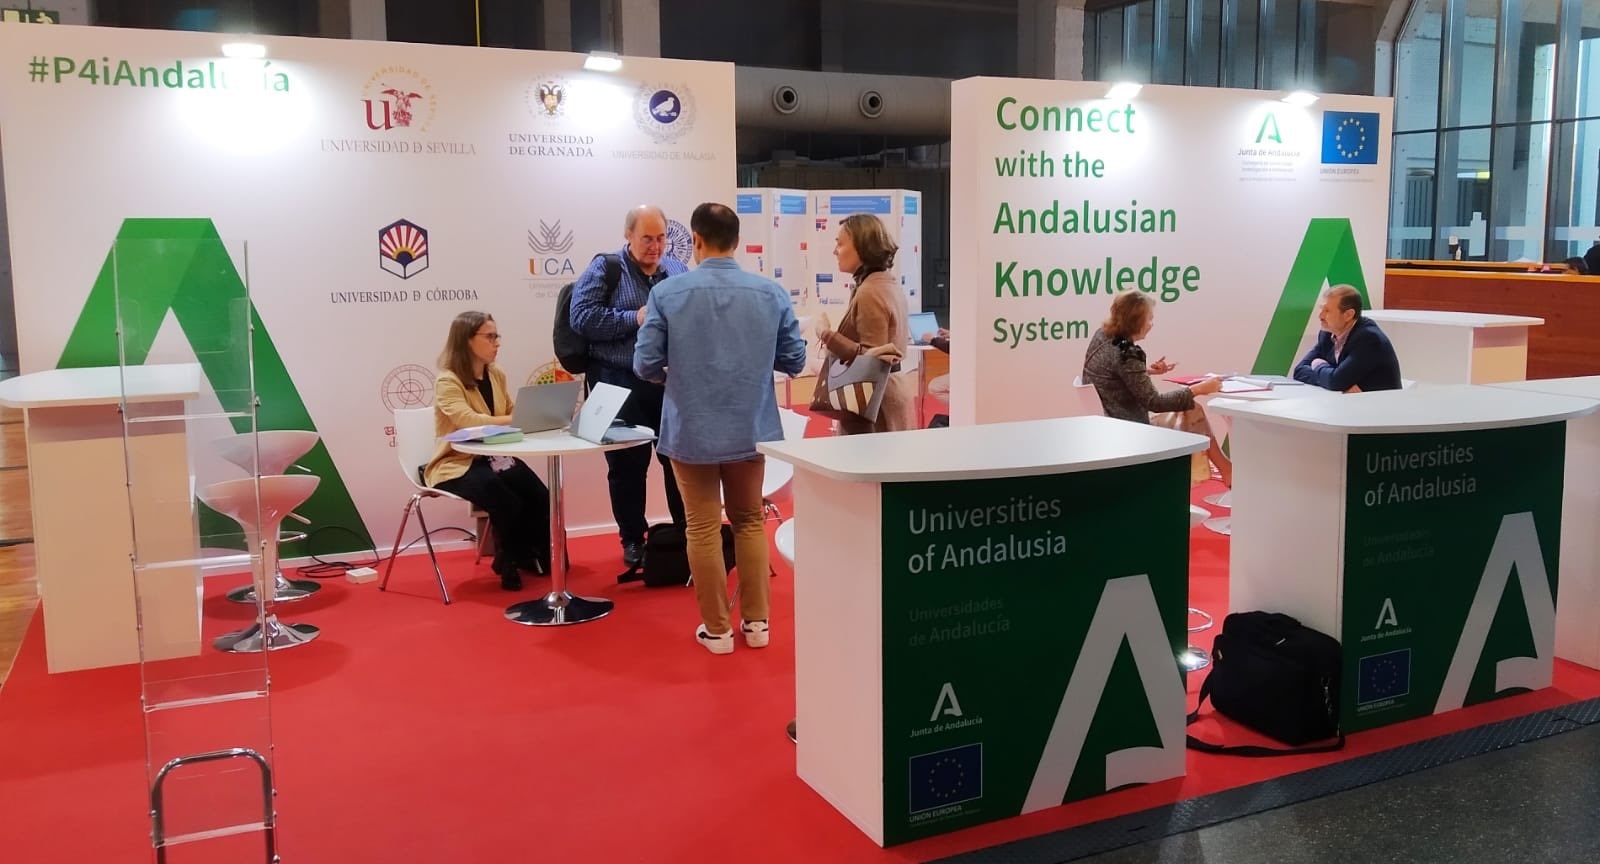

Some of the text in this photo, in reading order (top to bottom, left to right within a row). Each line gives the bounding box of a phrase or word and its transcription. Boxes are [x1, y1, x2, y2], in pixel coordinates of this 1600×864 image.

[996, 96, 1136, 134] Connect
[320, 138, 410, 154] UNIVERSIDAD
[426, 141, 477, 155] SEVILLA
[508, 133, 594, 146] UNIVERSIDAD
[508, 145, 595, 158] DE GRANADA
[995, 150, 1105, 178] with the
[993, 199, 1177, 234] Andalusian
[995, 256, 1201, 303] Knowledge
[331, 290, 408, 304] UNIVERSIDAD
[426, 288, 479, 302] CÓRDOBA
[993, 316, 1089, 349] System
[1366, 443, 1475, 475] Universities
[1364, 473, 1477, 507] of Andalusia
[908, 494, 1062, 535] Universities
[908, 530, 1067, 574] of Andalusia
[909, 597, 1003, 622] Universidades
[908, 613, 1011, 647] de Andalucía
[909, 716, 983, 739] Junta de Andalucía
[932, 804, 962, 818] EUROPEA
